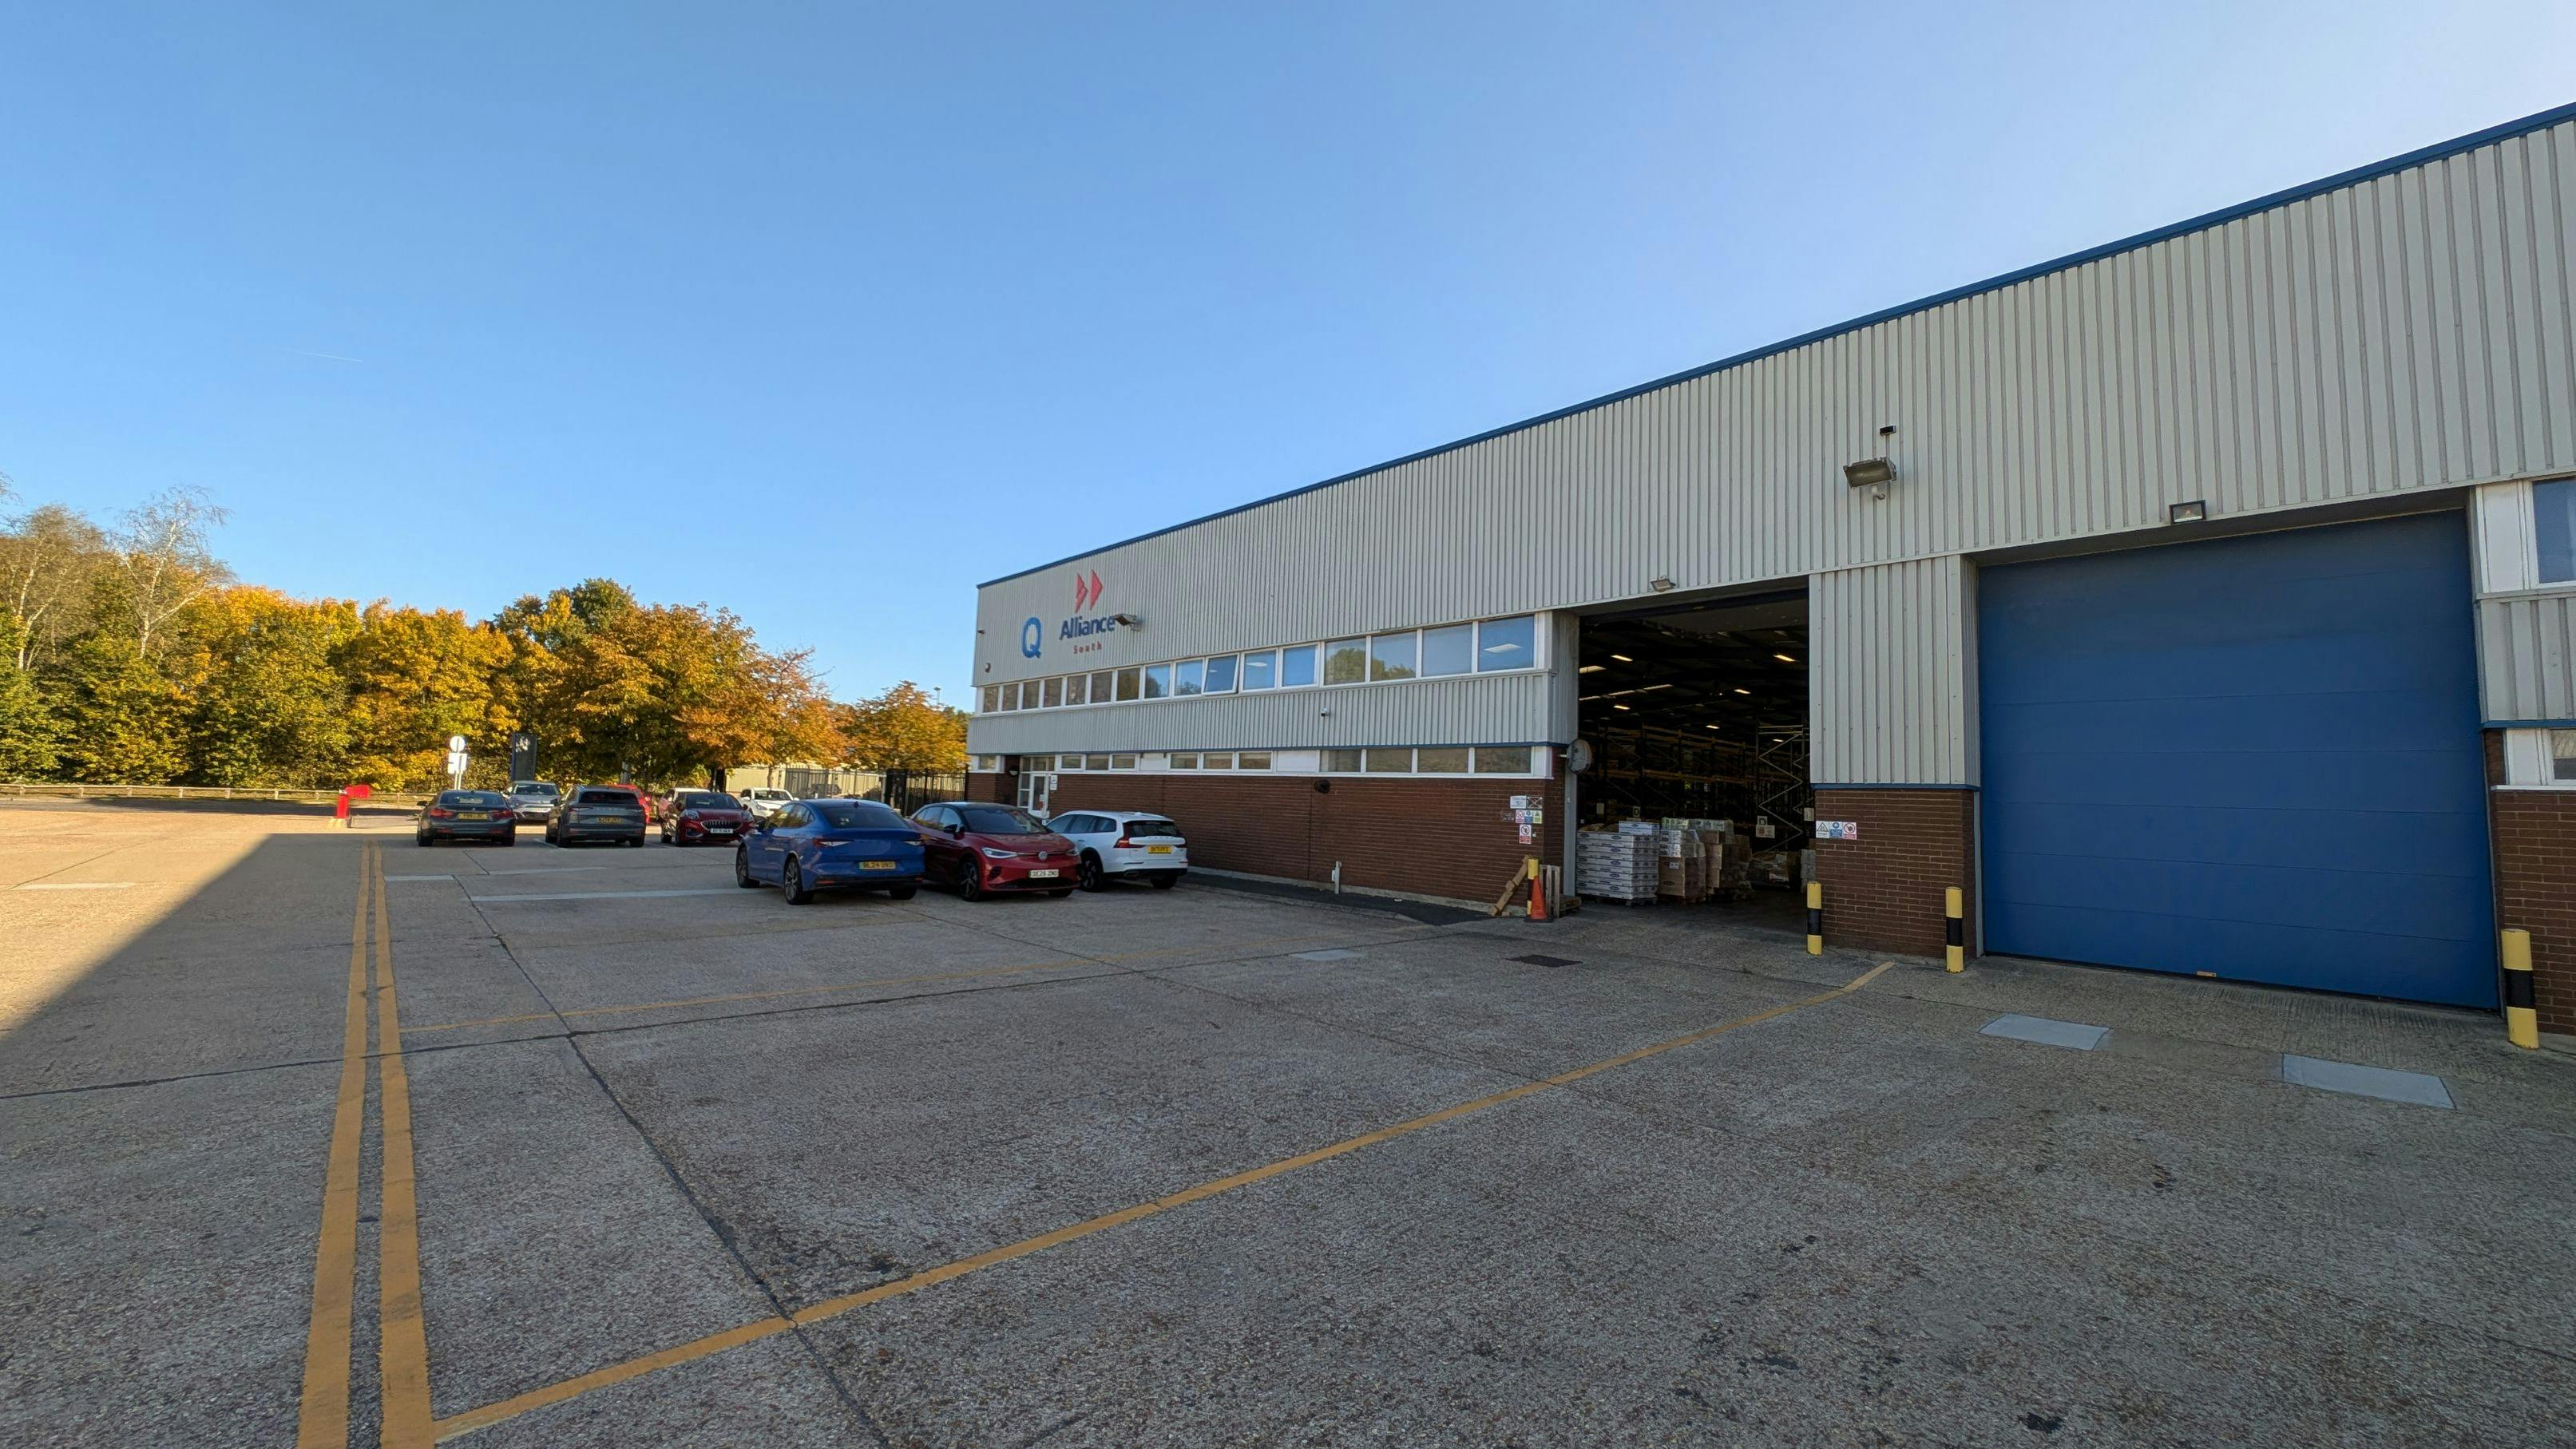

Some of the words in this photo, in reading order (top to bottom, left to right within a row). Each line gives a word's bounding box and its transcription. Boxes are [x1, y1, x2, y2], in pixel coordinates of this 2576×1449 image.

[1021, 616, 1041, 659] Q
[1059, 616, 1116, 640] Alliance
[1073, 640, 1102, 654] South
